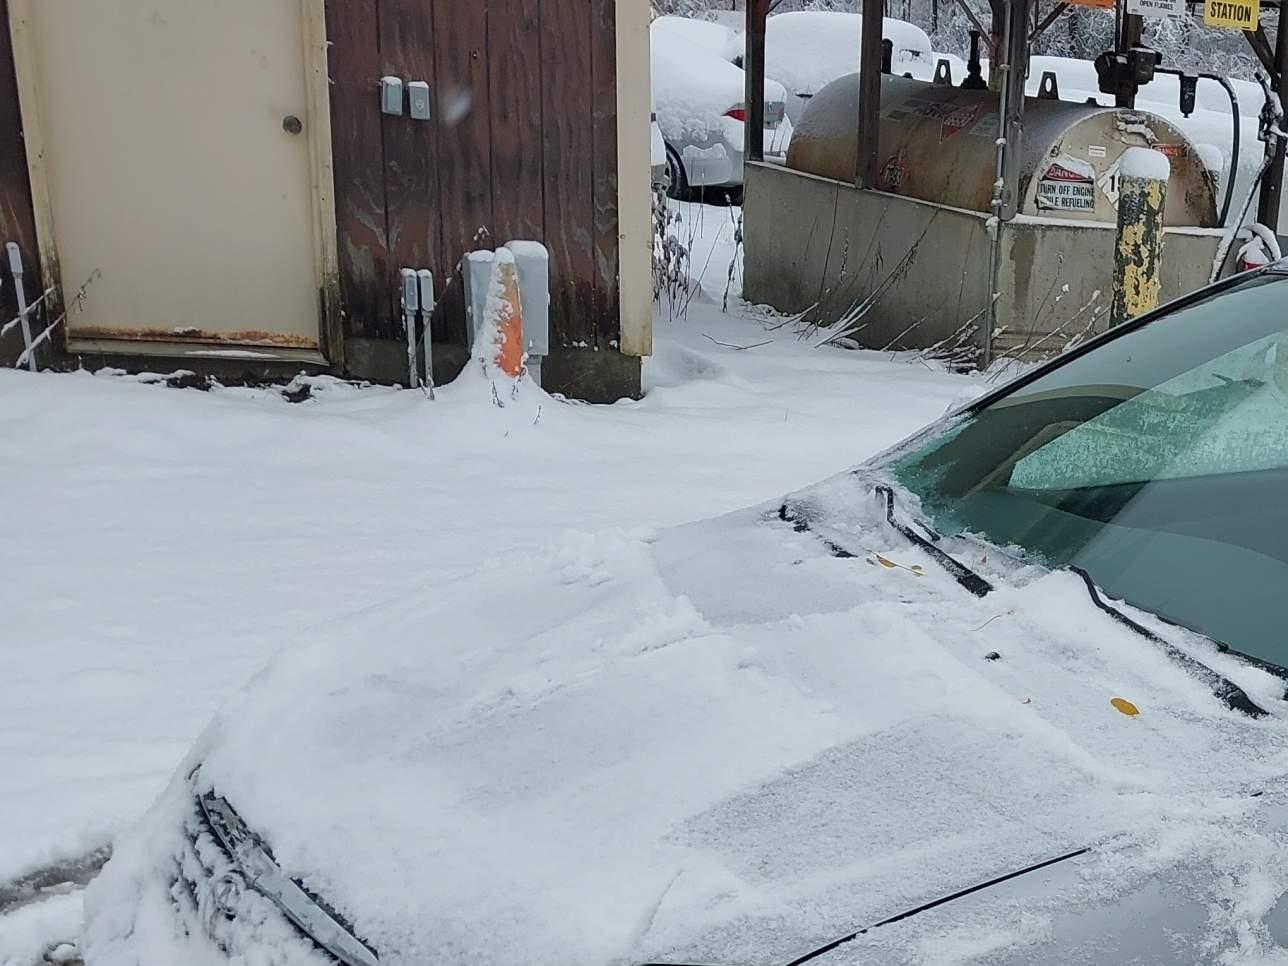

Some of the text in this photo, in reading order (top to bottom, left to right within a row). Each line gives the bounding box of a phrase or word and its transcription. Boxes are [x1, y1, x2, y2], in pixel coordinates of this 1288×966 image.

[1210, 2, 1252, 22] STATION
[1040, 183, 1056, 195] TURN
[1058, 185, 1071, 195] OFF
